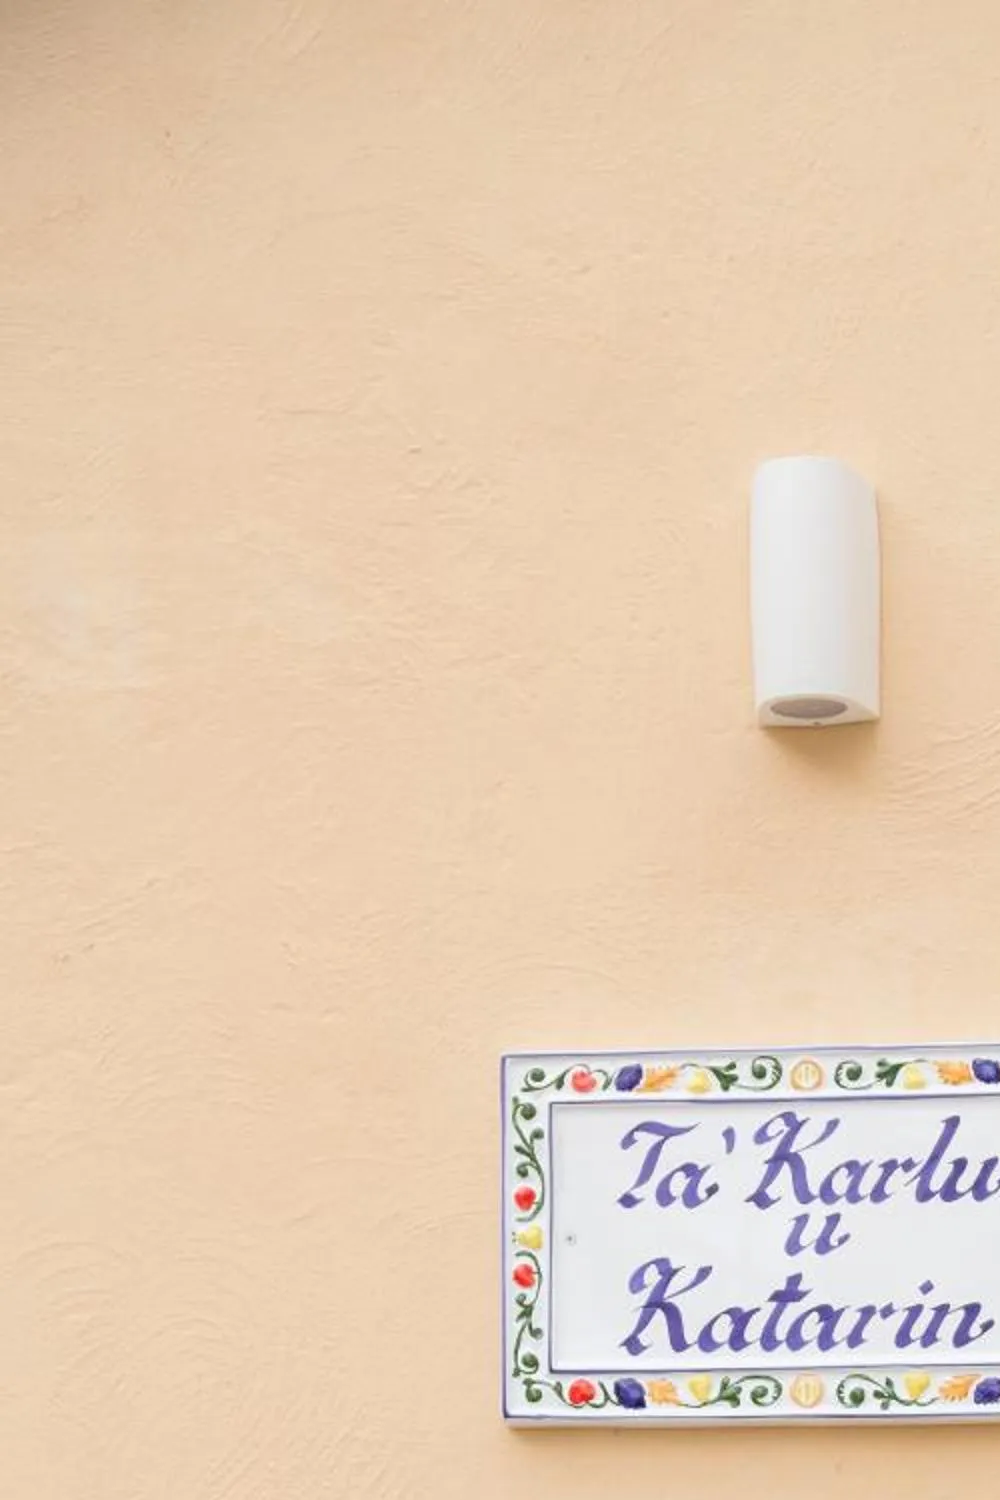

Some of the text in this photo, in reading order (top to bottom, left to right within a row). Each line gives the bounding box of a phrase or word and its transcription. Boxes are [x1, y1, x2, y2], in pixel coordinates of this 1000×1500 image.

[617, 1119, 739, 1210] Ta'
[783, 1213, 850, 1258] u
[618, 1257, 995, 1357] Katarin
